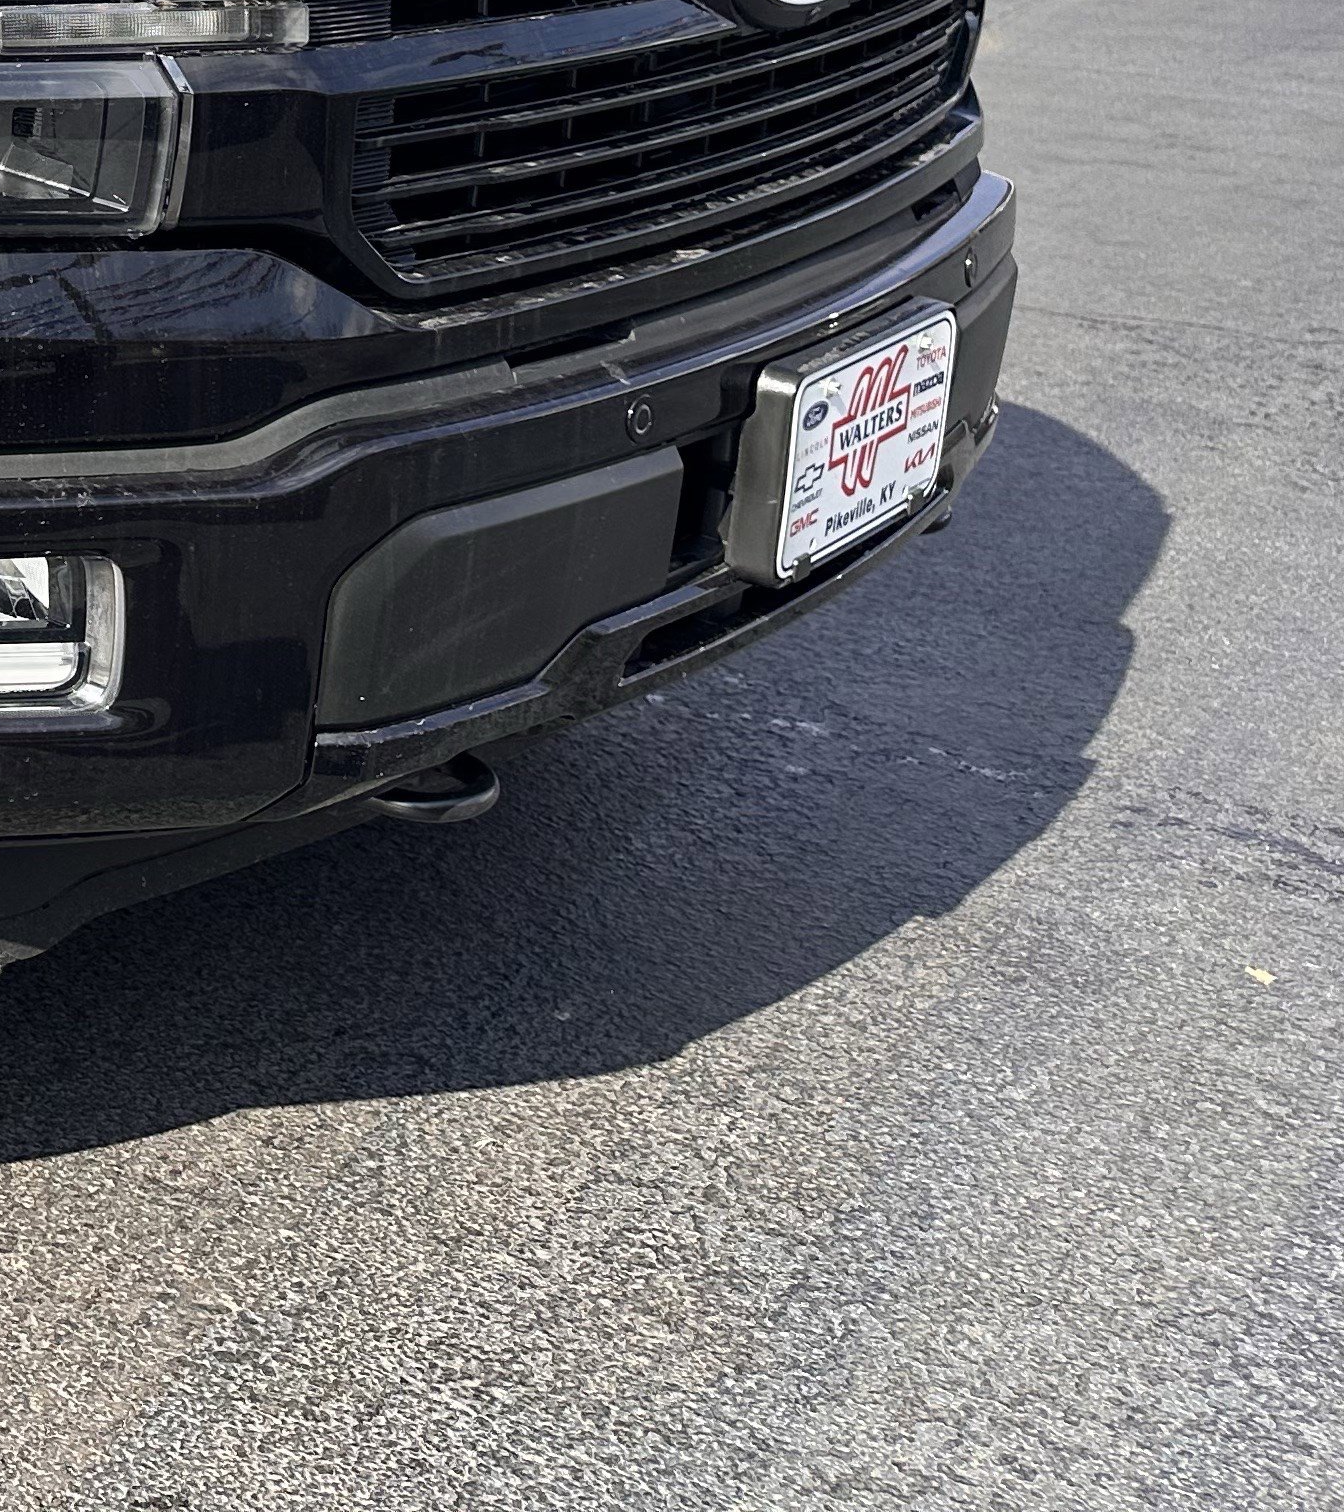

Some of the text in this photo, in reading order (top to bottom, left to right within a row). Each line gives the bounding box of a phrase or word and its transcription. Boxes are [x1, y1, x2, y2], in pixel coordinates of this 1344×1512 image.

[916, 345, 947, 371] TOYOTA
[912, 371, 945, 397] mazda
[839, 400, 903, 451] WALTERS
[907, 419, 940, 444] NISSAN
[796, 436, 829, 462] LINCOLN
[824, 480, 897, 537] Pikeville, KY
[790, 508, 819, 538] GMC
